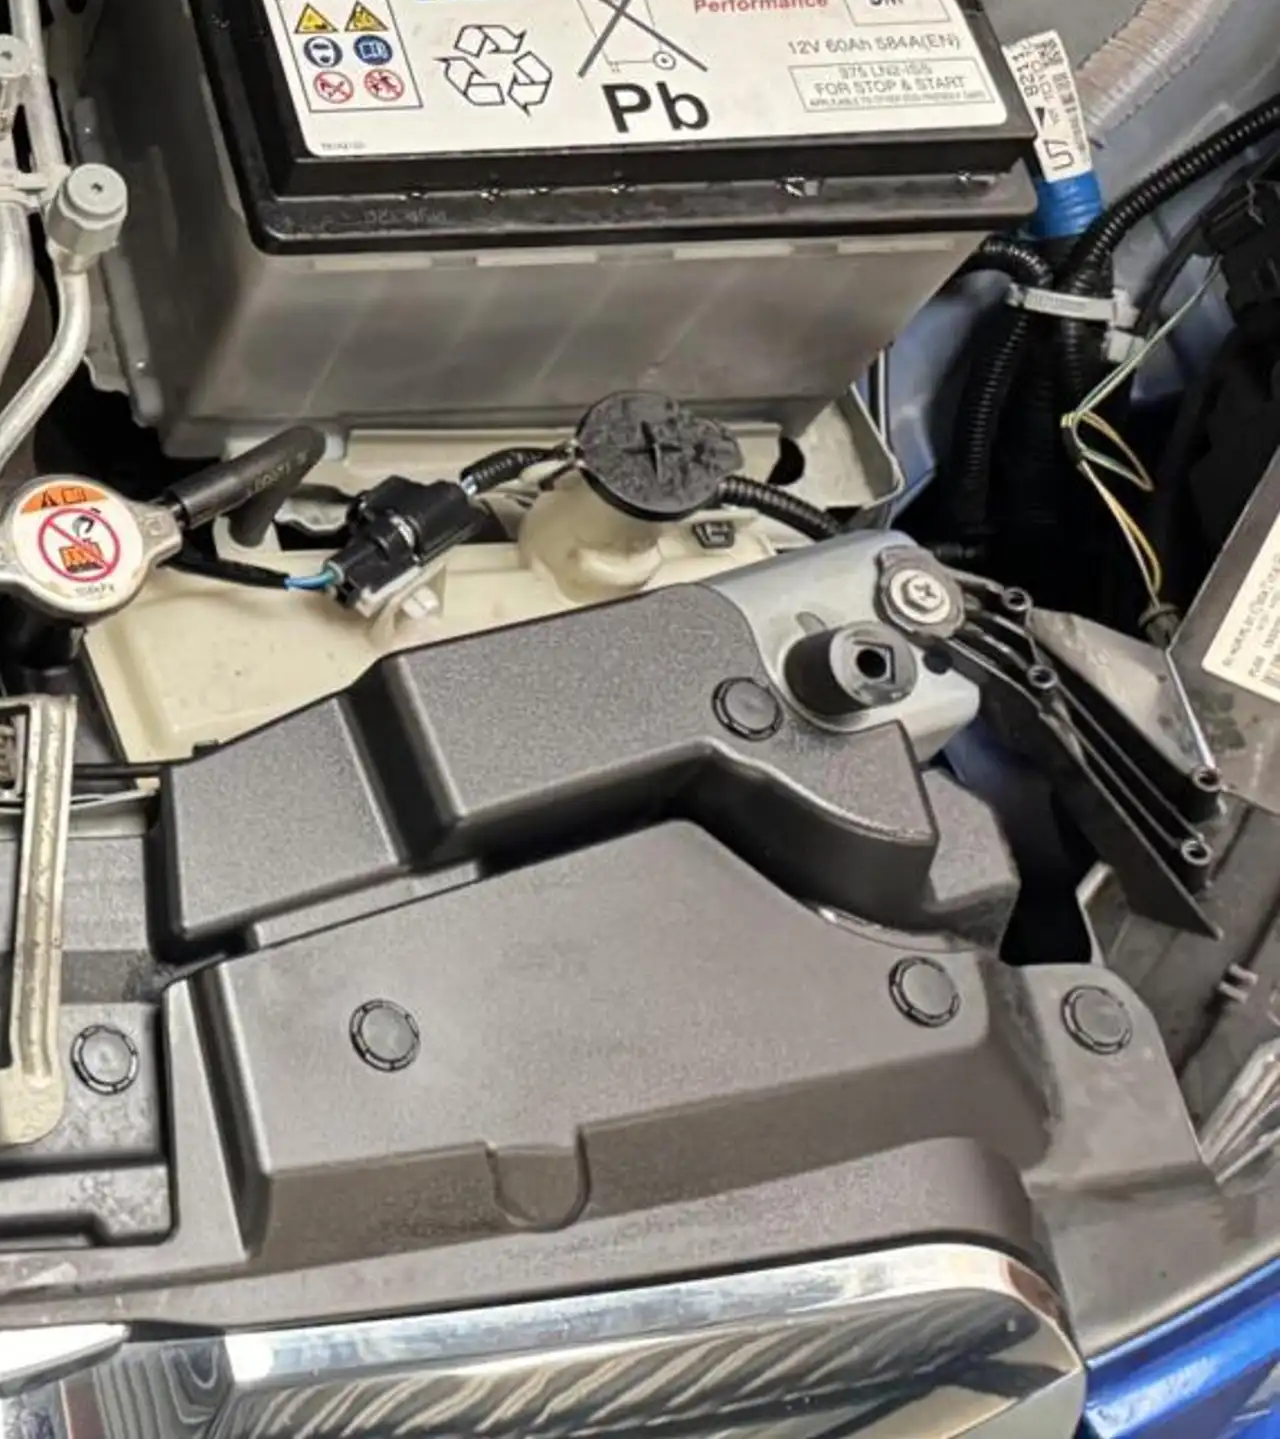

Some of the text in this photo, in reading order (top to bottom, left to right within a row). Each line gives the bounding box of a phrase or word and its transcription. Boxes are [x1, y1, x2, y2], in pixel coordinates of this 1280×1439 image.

[788, 38, 820, 55] 12V
[824, 35, 872, 53] 60Ah
[814, 81, 851, 96] FOR
[855, 79, 897, 93] STOP
[915, 76, 967, 91] START
[602, 81, 710, 133] Pb
